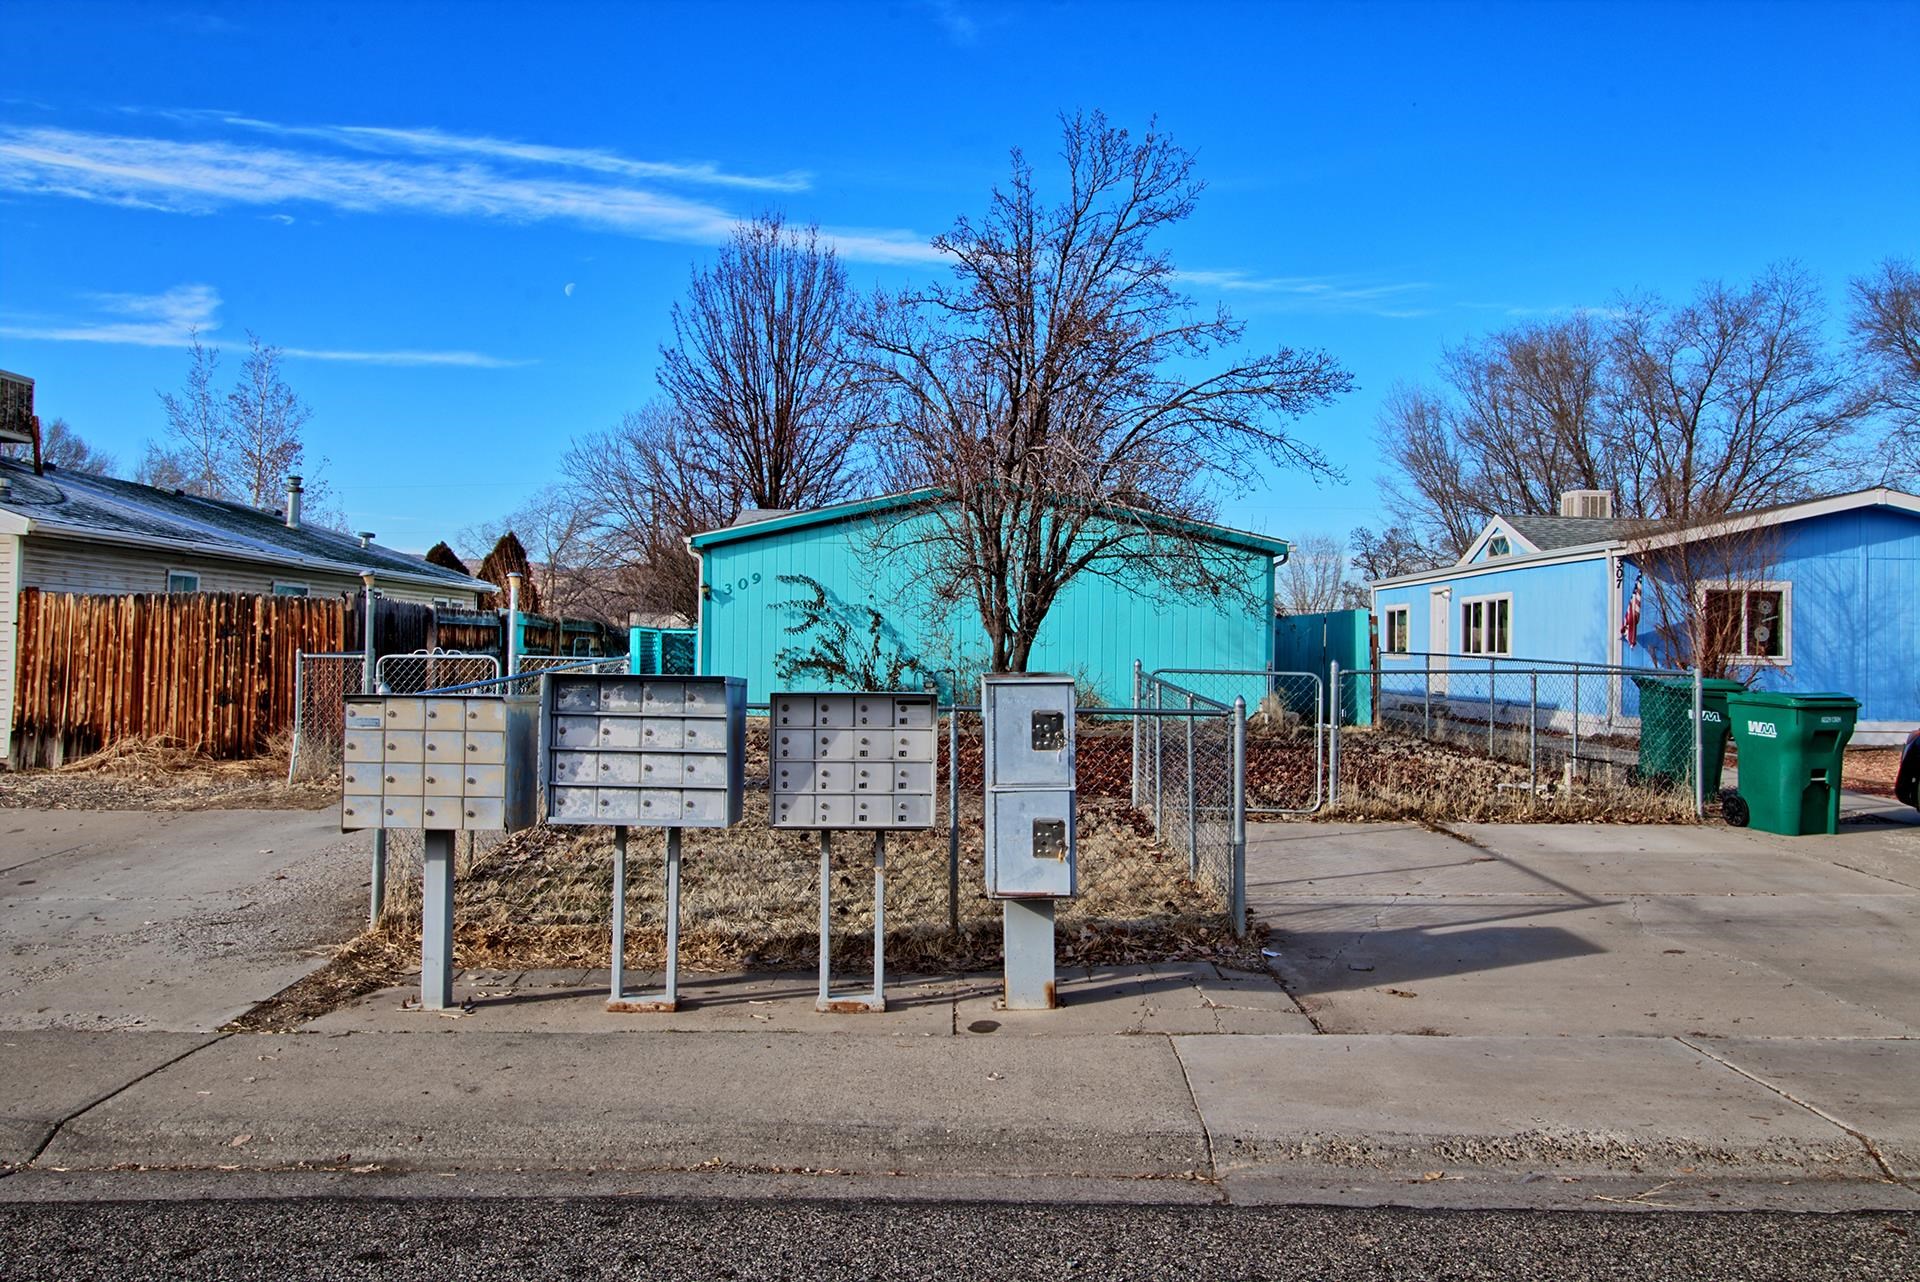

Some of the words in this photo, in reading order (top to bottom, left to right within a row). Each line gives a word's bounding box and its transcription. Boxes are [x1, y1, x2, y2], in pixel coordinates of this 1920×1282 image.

[723, 572, 762, 596] 309
[1616, 559, 1624, 589] 307
[1747, 720, 1777, 736] WM
